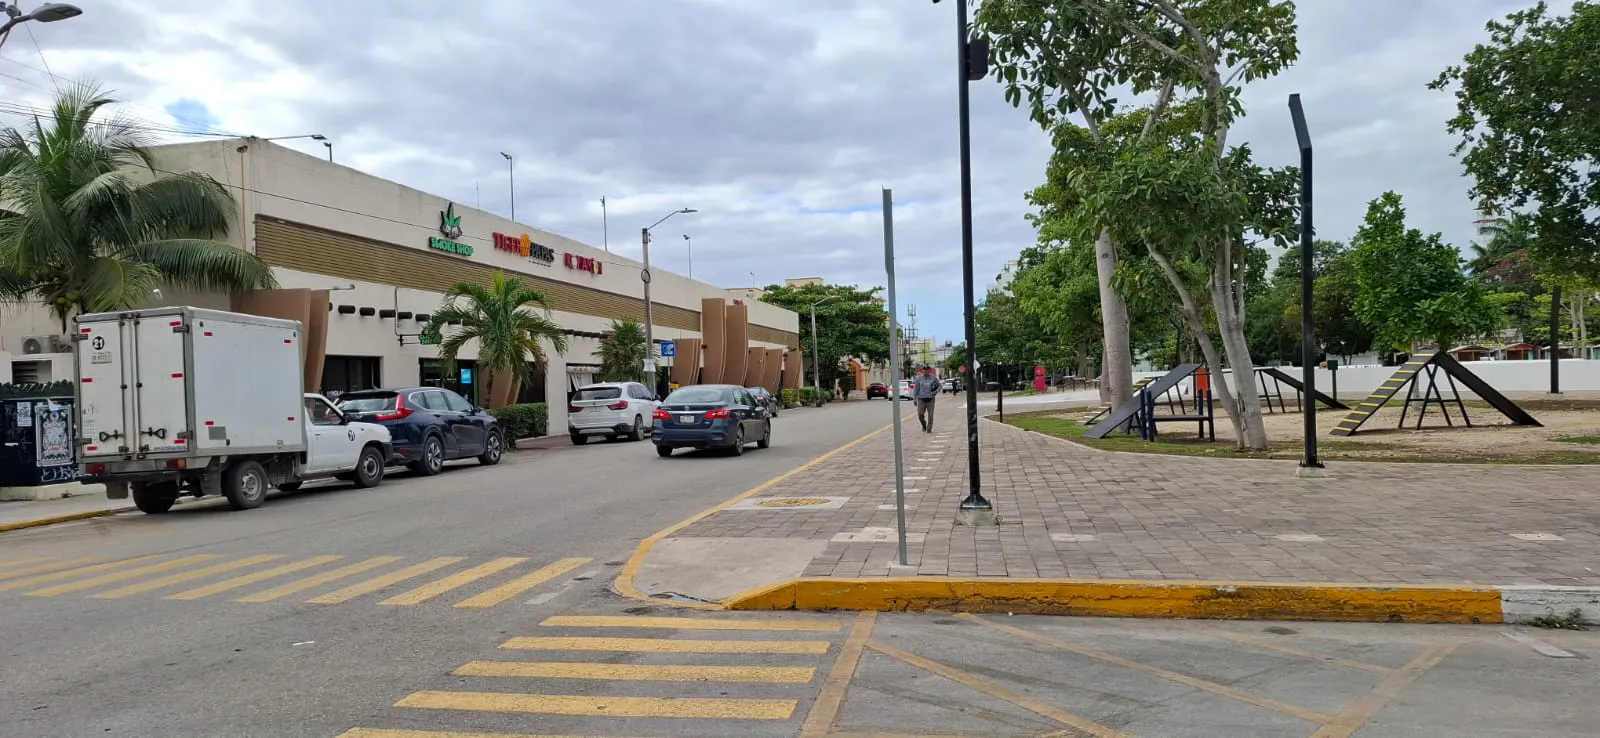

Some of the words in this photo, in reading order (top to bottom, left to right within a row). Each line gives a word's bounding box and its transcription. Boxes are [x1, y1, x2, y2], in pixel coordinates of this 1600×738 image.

[429, 236, 456, 253] SMOKE
[456, 243, 474, 256] SHOP
[530, 242, 555, 262] PAPAS
[93, 338, 104, 349] 21
